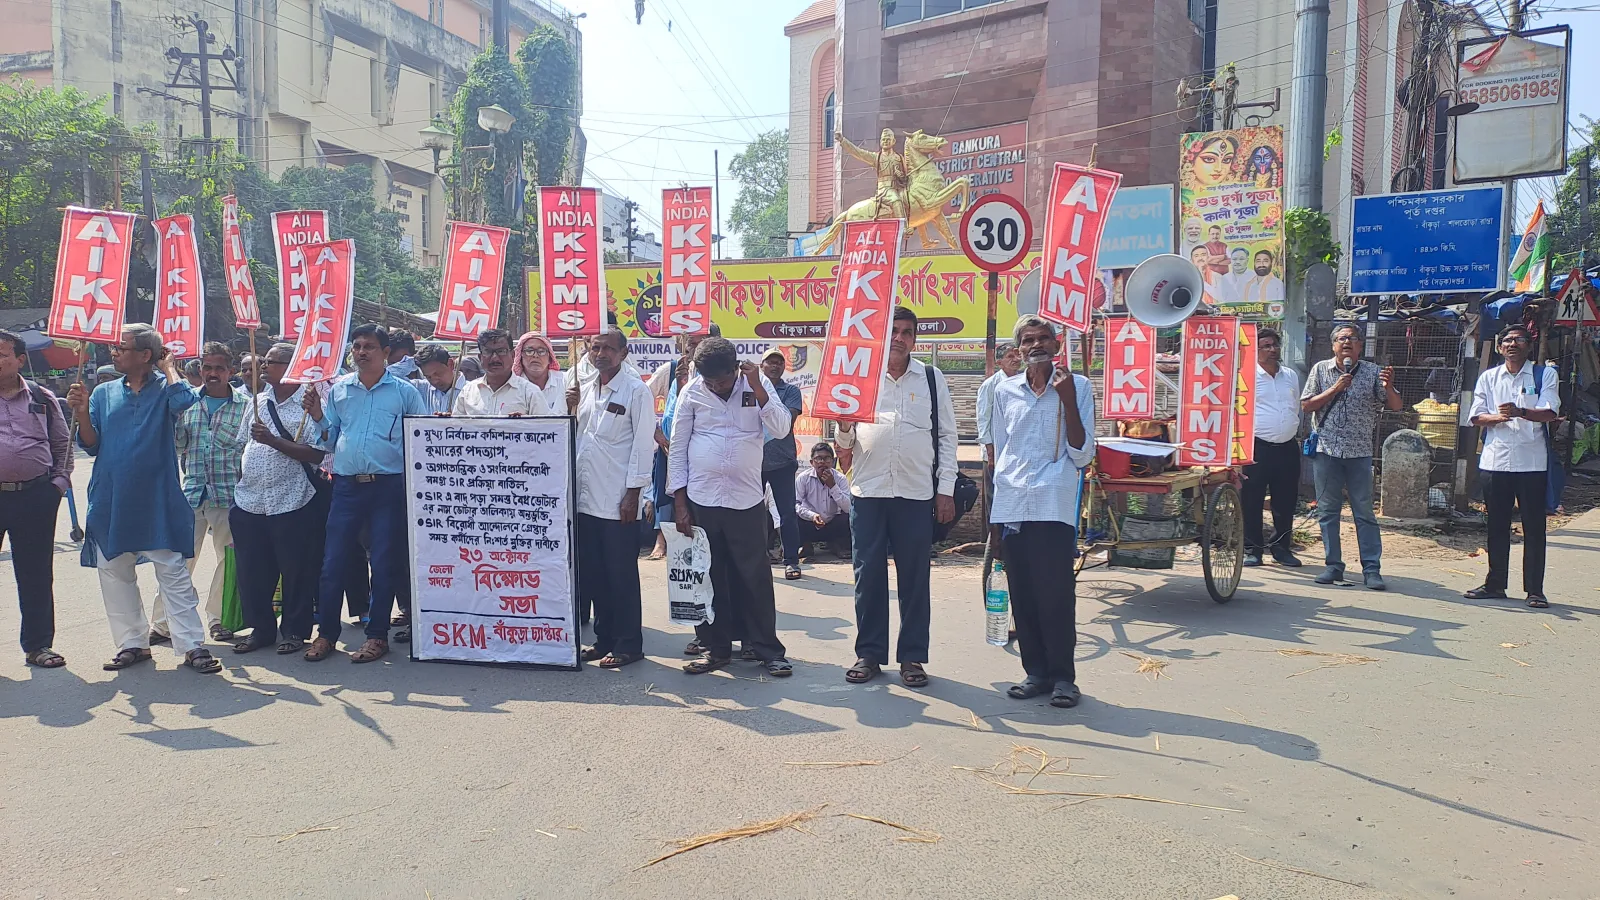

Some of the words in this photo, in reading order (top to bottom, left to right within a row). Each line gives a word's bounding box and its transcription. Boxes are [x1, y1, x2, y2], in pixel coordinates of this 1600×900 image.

[952, 134, 1001, 155] BANKURA
[935, 156, 975, 174] ISTRICT
[977, 149, 1025, 168] CENTRAL
[671, 191, 702, 205] ALL
[1221, 190, 1243, 207] দুর্গা
[1387, 196, 1427, 207] পশ্চিমবঙ্গ
[1432, 194, 1465, 204] সরকার
[547, 211, 594, 227] INDIA
[666, 205, 709, 220] INDIA
[1111, 201, 1163, 220] নতলা
[1203, 207, 1231, 223] কালী
[1233, 205, 1259, 219] পূজা
[1403, 206, 1421, 219] পূর্ত
[1425, 206, 1446, 216] দপ্তর
[973, 216, 1019, 252] 30
[1421, 220, 1440, 232] বাঁকুড়া
[283, 231, 323, 246] INDIA
[855, 230, 884, 245] ALL
[1101, 234, 1164, 252] HANTALA
[848, 250, 888, 265] INDIA
[1048, 175, 1098, 323] AIKM
[226, 203, 257, 320] AIKM
[61, 215, 121, 335] AIKM
[666, 223, 707, 333] KKMS
[1419, 265, 1438, 276] বাঁকুড়া
[1453, 265, 1470, 274] সড়ক
[163, 220, 190, 355] AIKKMS
[445, 230, 496, 334] AIKM
[553, 231, 588, 330] KKMS
[711, 271, 775, 318] বাঁকুড়া
[302, 247, 339, 380] AIKKMS
[778, 323, 808, 337] বাঁকুড়া
[1195, 323, 1223, 335] ALL
[627, 343, 671, 354] ANKURA
[735, 343, 770, 354] OLICE
[827, 269, 884, 415] KKMS
[1190, 338, 1228, 350] INDIA
[637, 356, 671, 373] বাঁকু
[1111, 321, 1148, 413] AIKM
[1188, 353, 1225, 462] KKMS
[445, 427, 479, 441] নির্বাচন
[480, 429, 521, 443] কমিশনার
[524, 431, 558, 444] জ্ঞানেশ
[425, 446, 463, 458] কুমারের
[466, 445, 509, 460] পদত্যাগ,
[426, 460, 476, 475] অগণতান্ত্রিক
[479, 465, 486, 475] ও
[425, 475, 447, 486] সমগ্র
[450, 478, 465, 487] SIR
[467, 476, 495, 491] প্রক্রিয়া
[498, 476, 529, 492] বাতিল,
[425, 492, 443, 501] SIR
[445, 492, 451, 501] এ
[470, 493, 487, 505] পড়া
[490, 494, 511, 505] সমস্ত
[512, 491, 530, 507] বৈধ
[530, 494, 560, 508] ভোটার
[422, 504, 434, 513] এর
[437, 504, 451, 514] নাম
[453, 504, 478, 517] ভোটার
[480, 505, 516, 519] তালিকায়
[425, 519, 443, 529] SIR
[446, 516, 475, 530] বিরোধী
[478, 521, 520, 534] আন্দোলনে
[428, 533, 448, 543] সমস্ত
[511, 536, 532, 550] মুক্তির
[459, 546, 483, 564] ২৩
[489, 549, 531, 564] অক্টোবর
[428, 564, 455, 575] জেলা
[472, 563, 541, 592] বিক্ষোভ
[428, 577, 454, 589] সদরে
[499, 595, 539, 615] সভা
[493, 619, 528, 644] বাঁকুড়া
